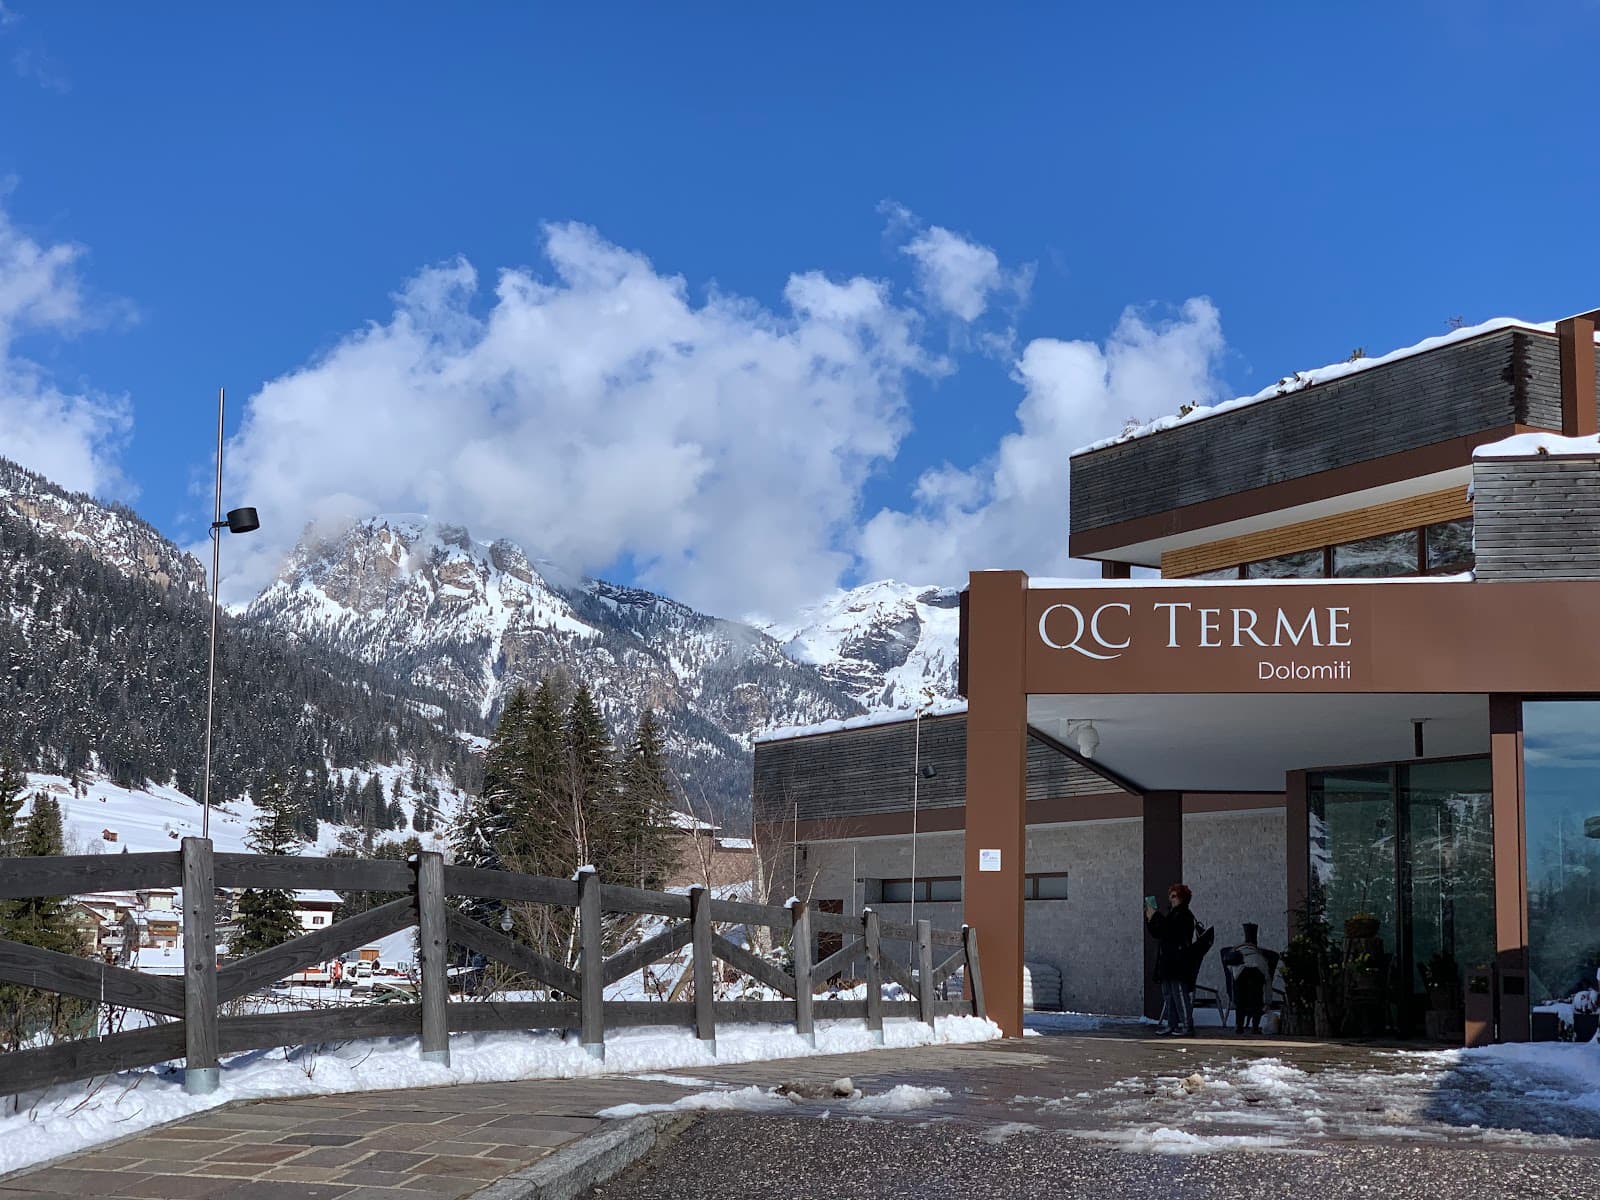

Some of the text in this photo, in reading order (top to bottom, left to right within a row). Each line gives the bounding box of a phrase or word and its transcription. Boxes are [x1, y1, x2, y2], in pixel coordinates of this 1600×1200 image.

[1038, 602, 1352, 660] QC TERME
[1258, 661, 1351, 680] Dolomiti
